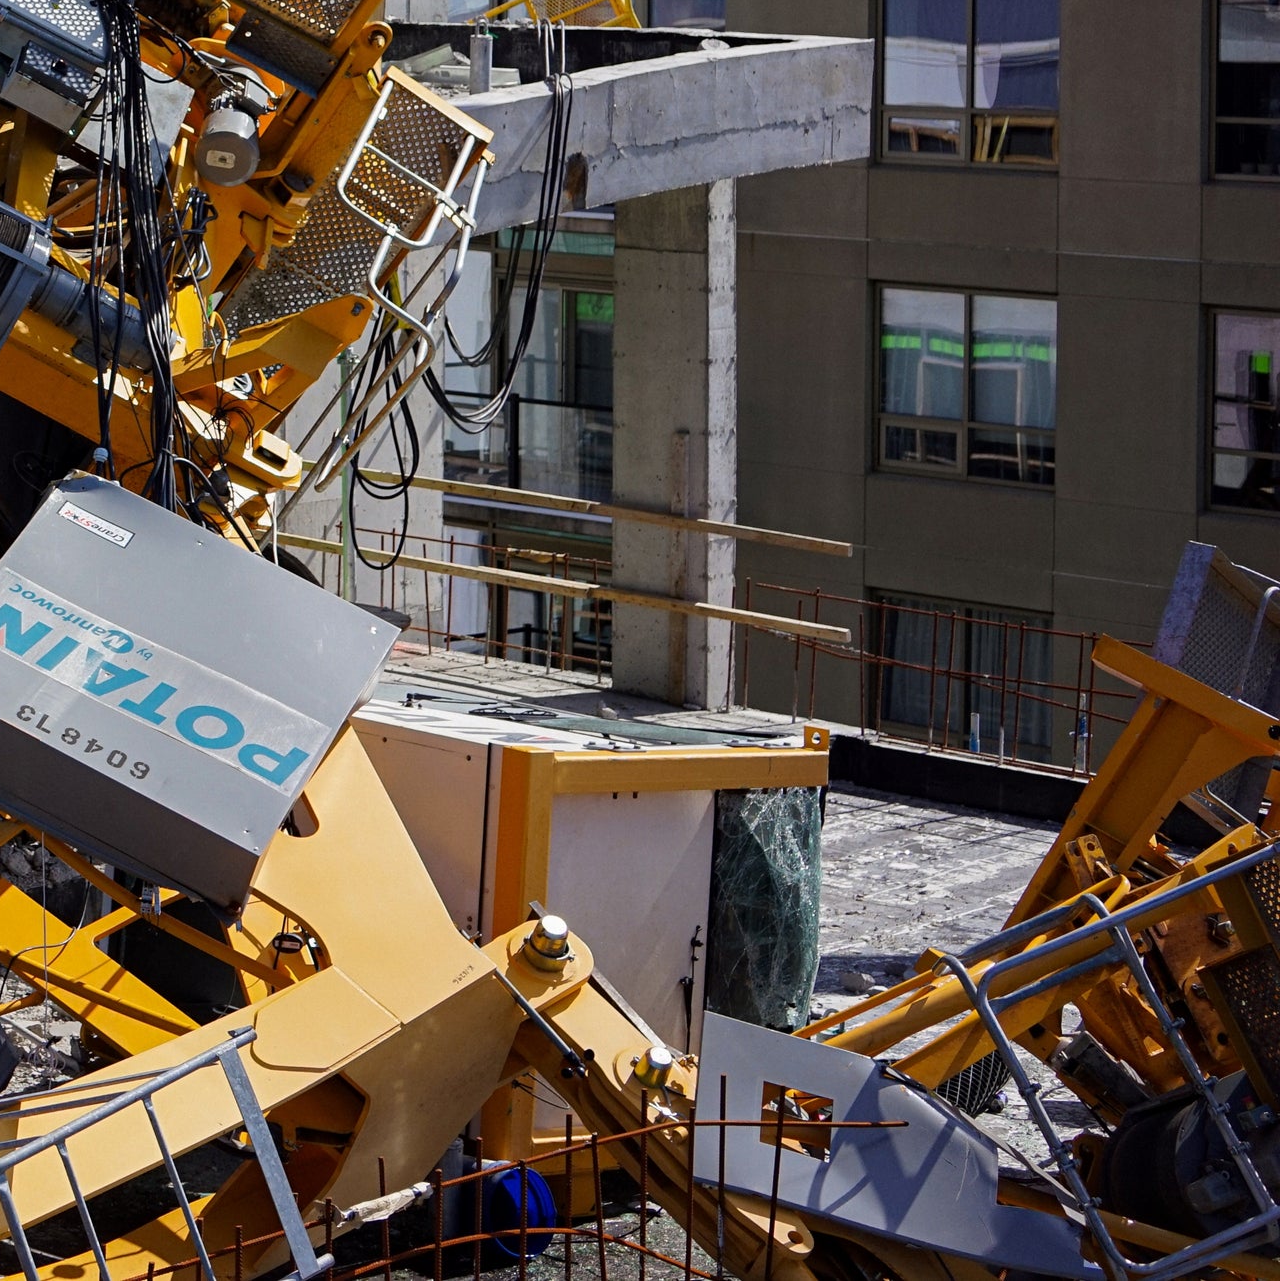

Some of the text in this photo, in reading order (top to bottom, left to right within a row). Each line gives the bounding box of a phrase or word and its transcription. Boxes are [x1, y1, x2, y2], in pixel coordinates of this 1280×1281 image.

[8, 583, 154, 661] by Manitowoc
[16, 703, 151, 780] 604873
